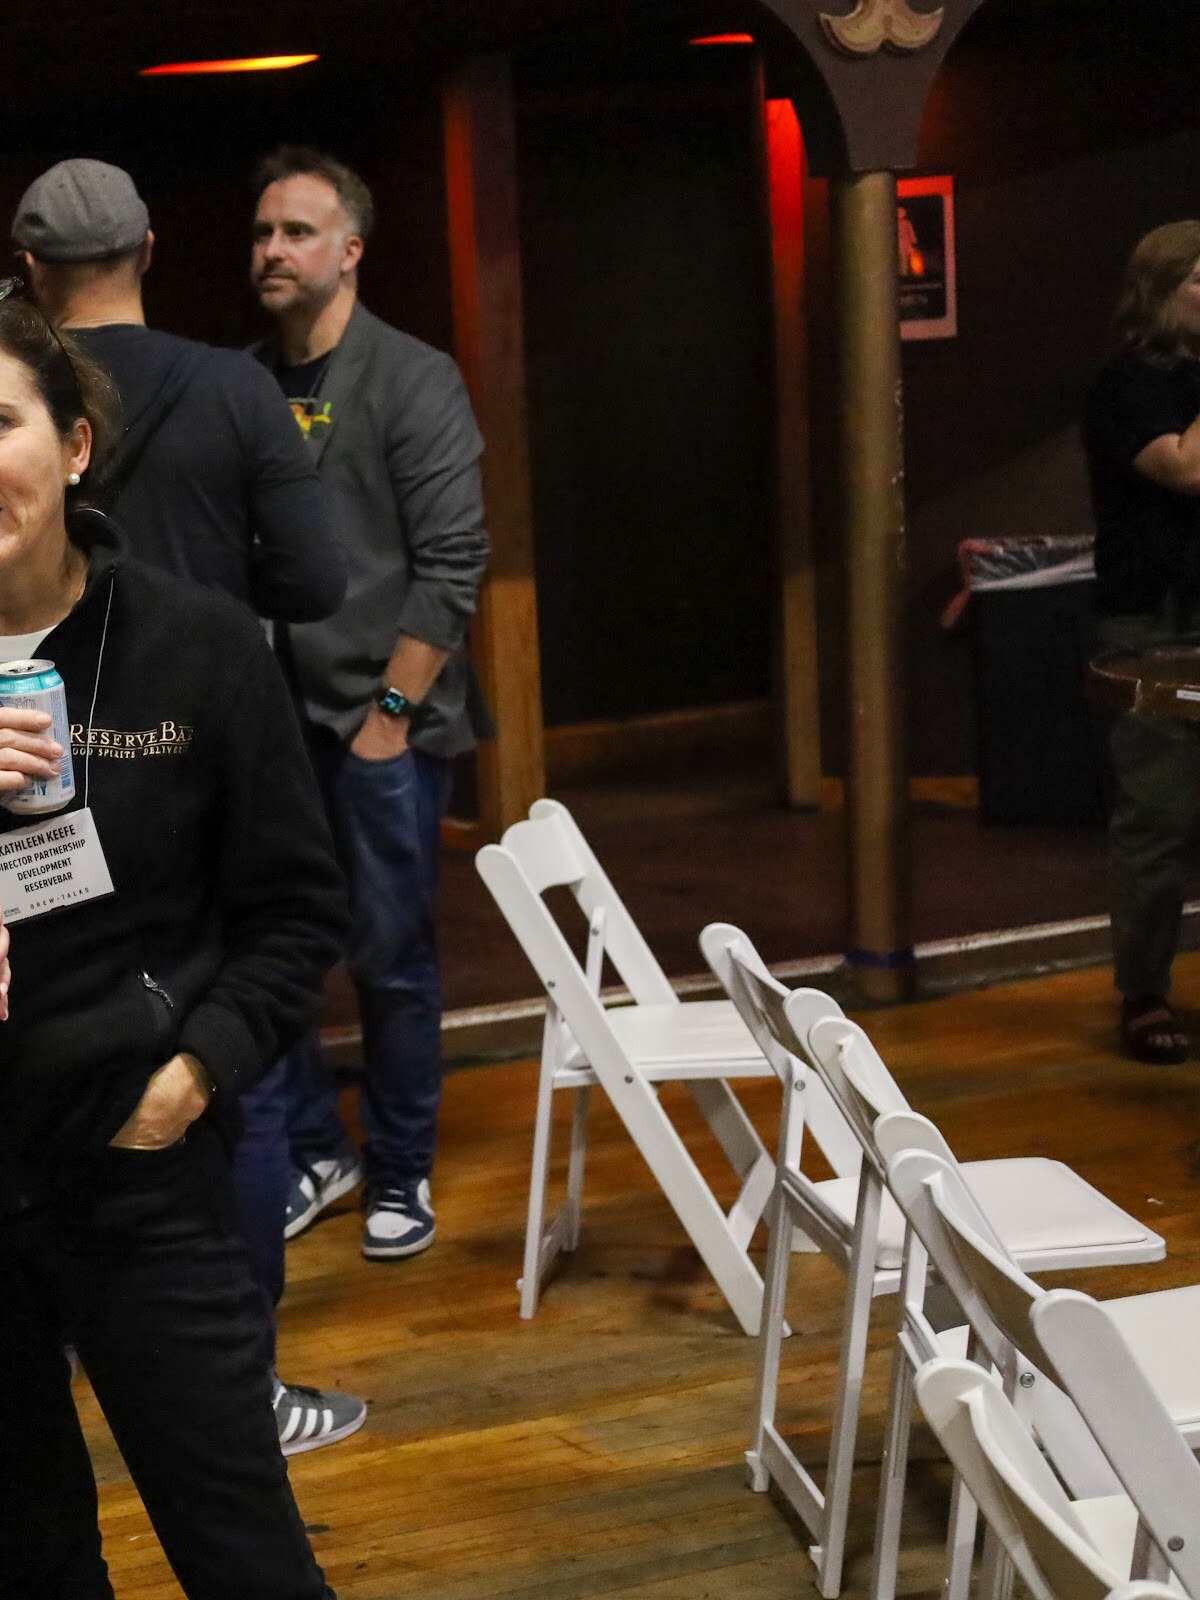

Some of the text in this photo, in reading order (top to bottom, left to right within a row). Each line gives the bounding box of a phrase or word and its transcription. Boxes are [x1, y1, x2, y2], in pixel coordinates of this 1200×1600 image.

[72, 747, 94, 756] OOD
[98, 748, 136, 759] SPIRITS
[46, 824, 76, 843] KEEFE
[34, 838, 86, 862] PARTNERSHIP
[17, 857, 72, 881] DEVELOPMENT
[24, 871, 74, 893] RESERVEBAR
